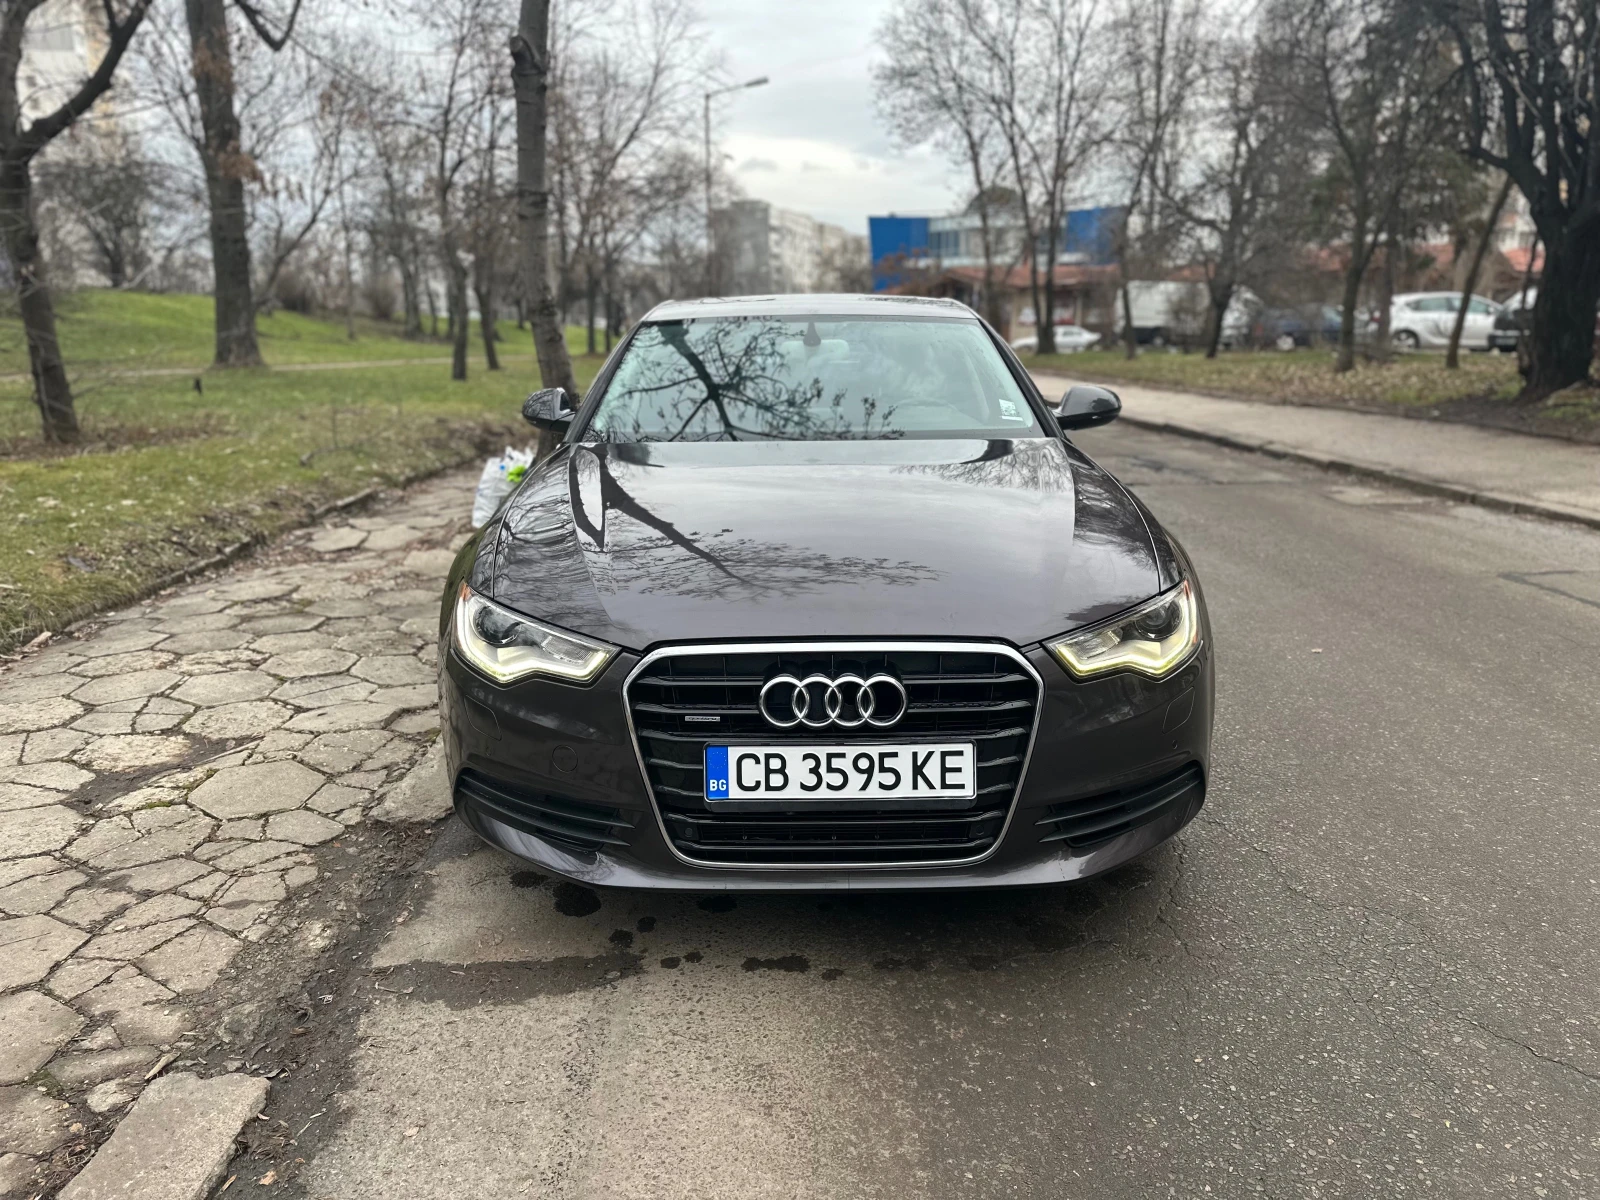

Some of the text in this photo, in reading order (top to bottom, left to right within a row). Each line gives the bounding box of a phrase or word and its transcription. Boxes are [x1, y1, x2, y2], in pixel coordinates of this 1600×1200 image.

[736, 750, 966, 792] CB 3595 KE
[709, 779, 727, 791] BG
